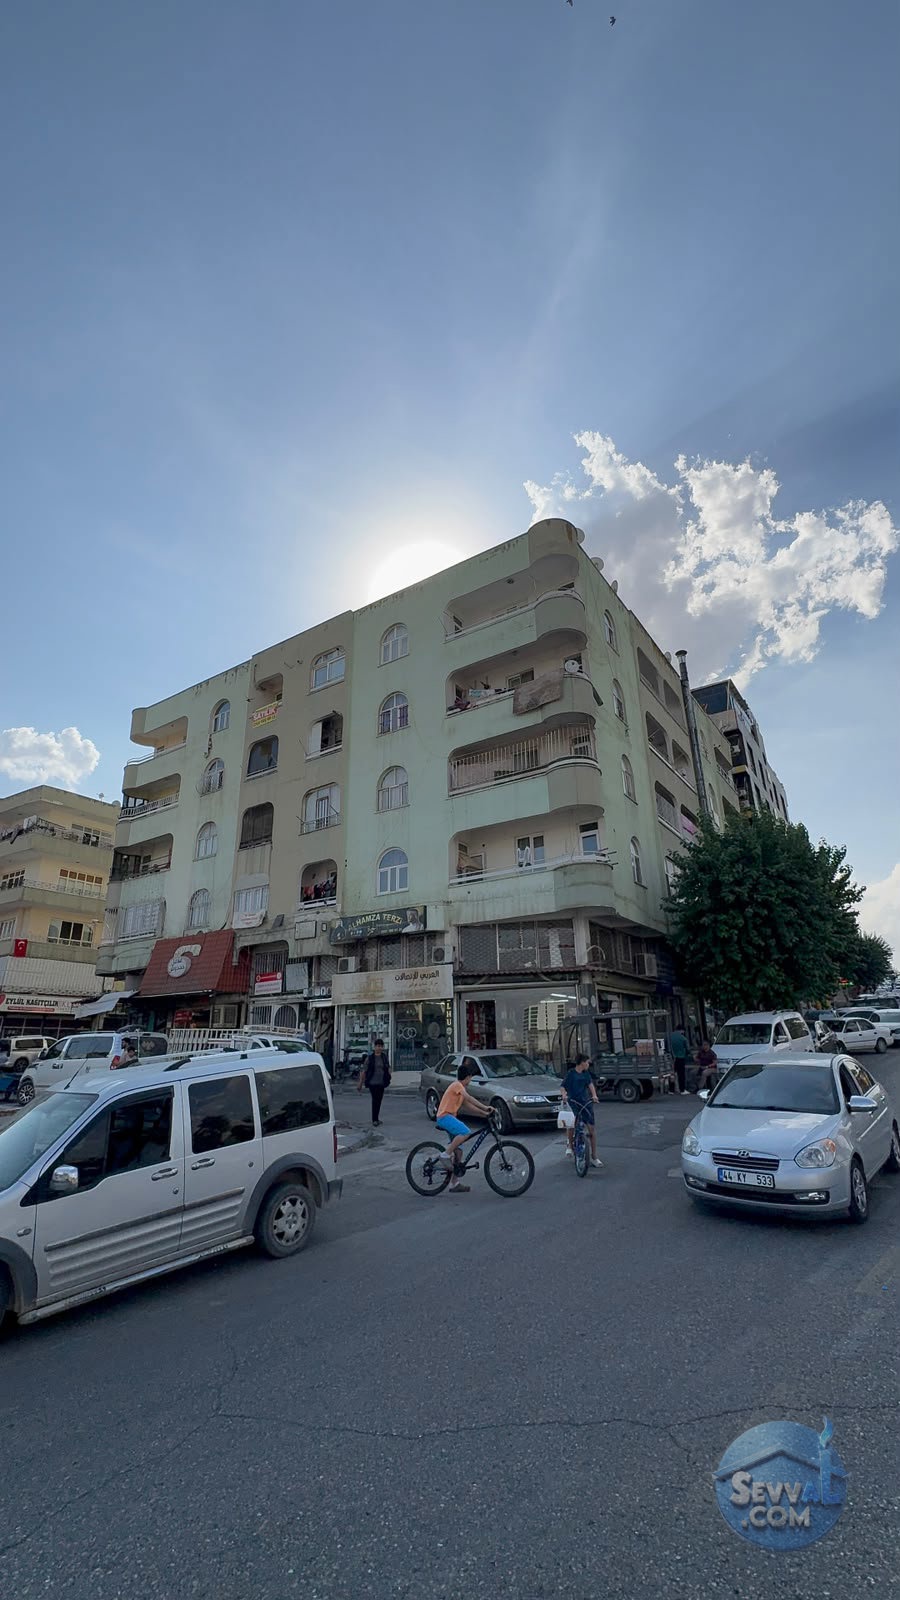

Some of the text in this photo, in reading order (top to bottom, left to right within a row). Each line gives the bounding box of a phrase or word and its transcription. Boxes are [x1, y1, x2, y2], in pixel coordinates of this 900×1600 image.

[723, 1171, 773, 1186] 44 KY 533
